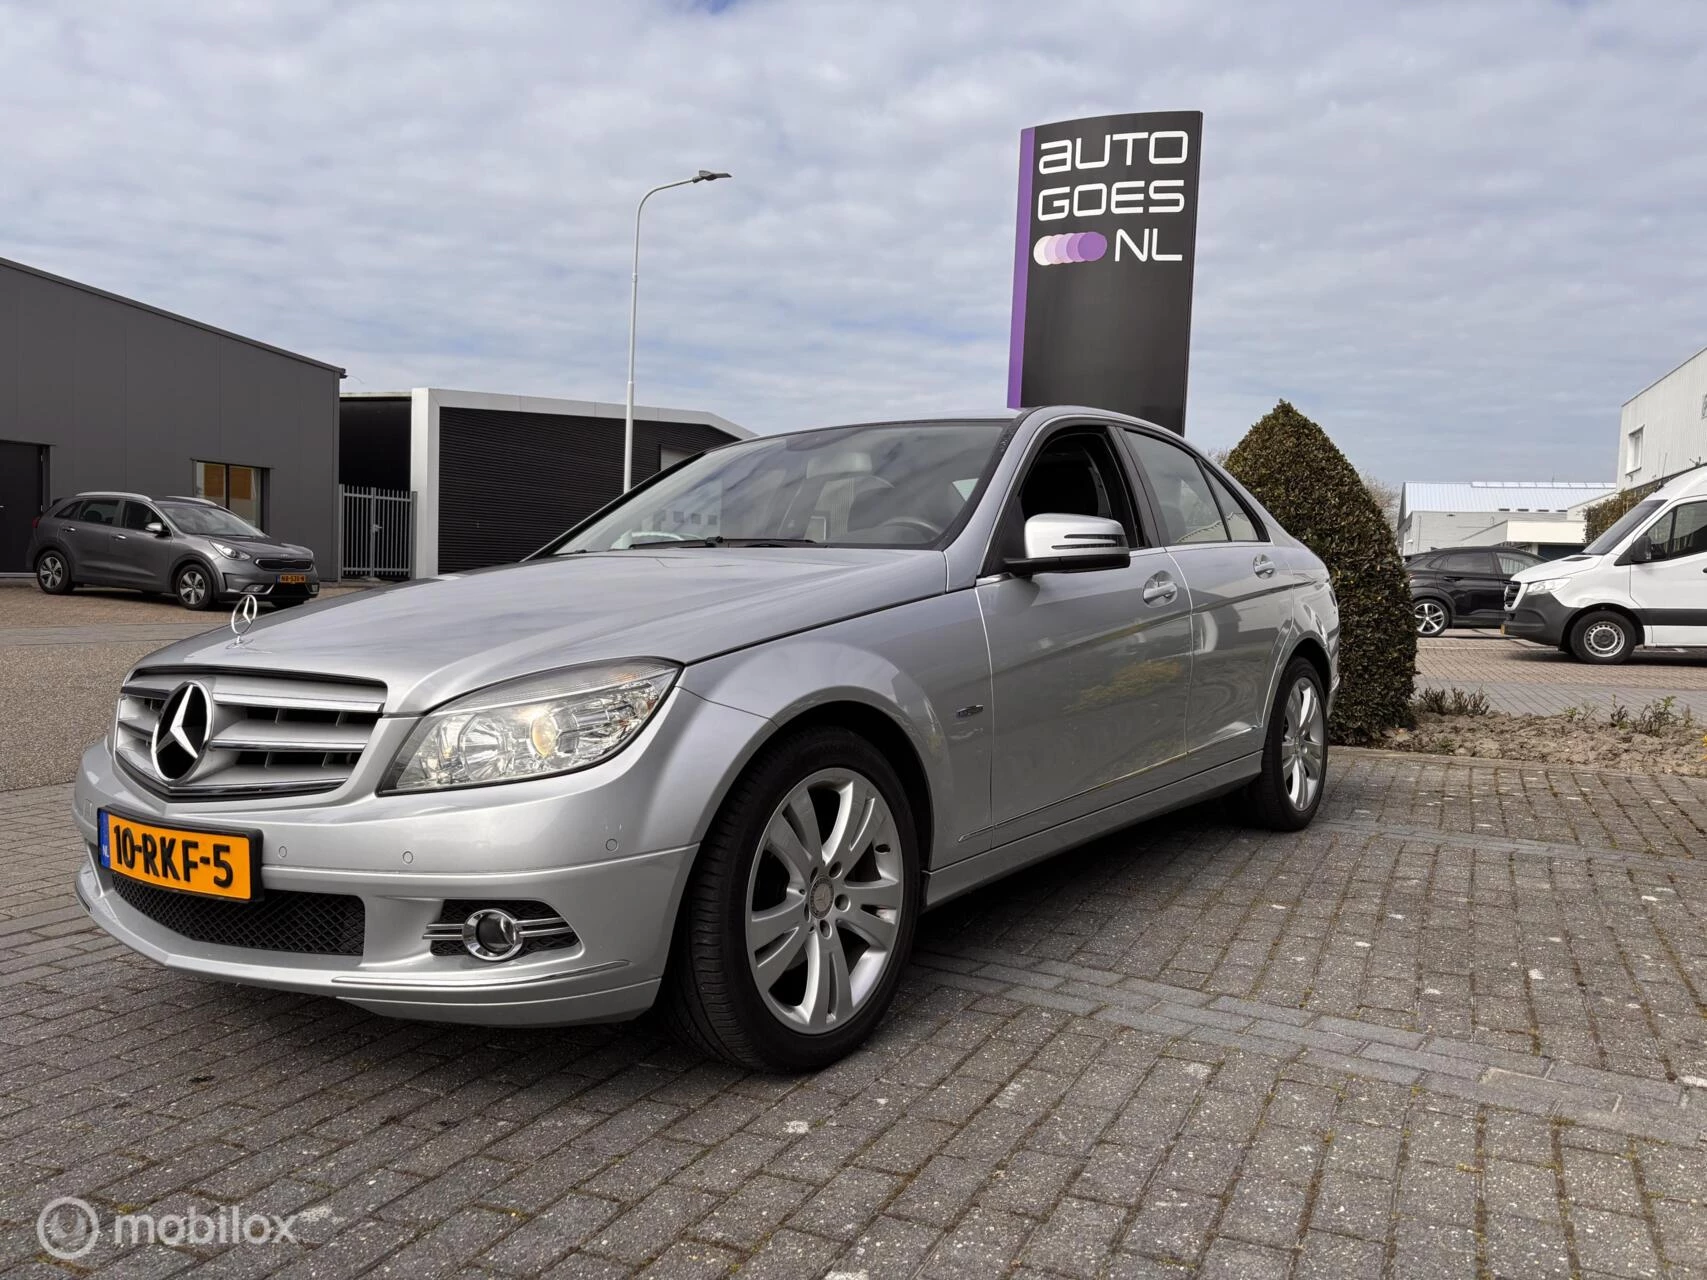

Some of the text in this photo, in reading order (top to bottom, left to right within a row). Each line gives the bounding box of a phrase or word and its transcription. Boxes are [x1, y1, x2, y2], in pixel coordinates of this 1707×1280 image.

[1038, 179, 1185, 221] GOES
[1115, 228, 1183, 262] NL
[114, 824, 233, 889] 10-RKF-5
